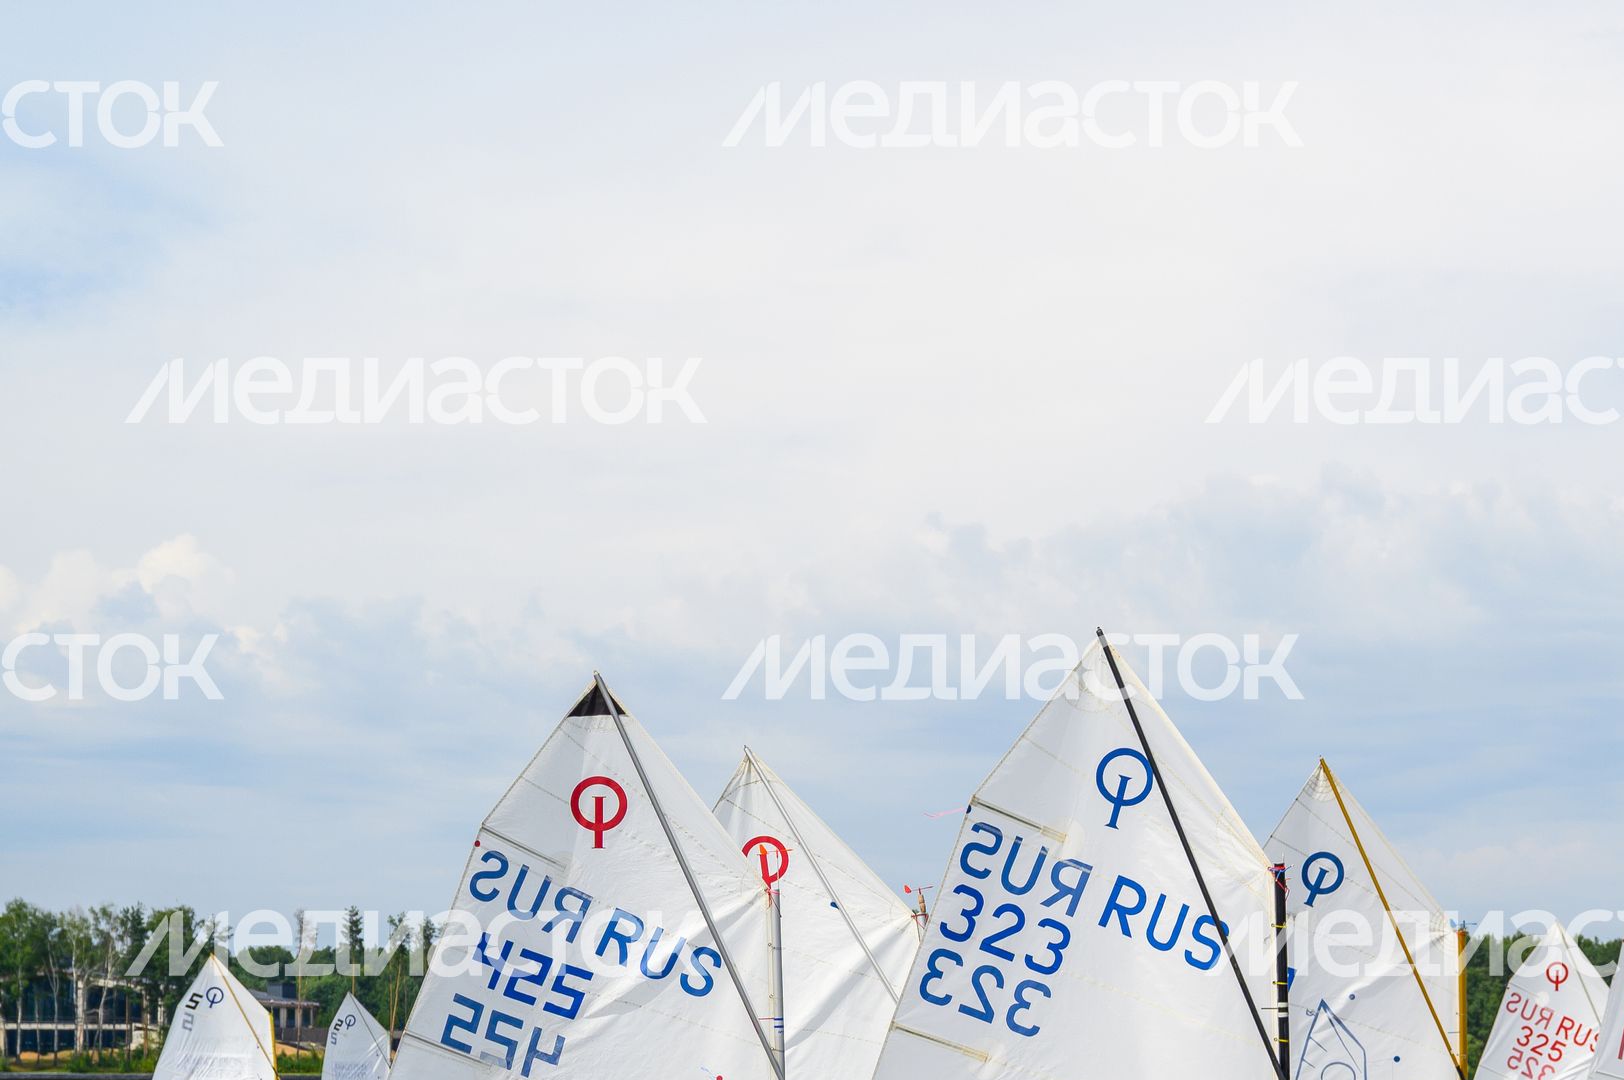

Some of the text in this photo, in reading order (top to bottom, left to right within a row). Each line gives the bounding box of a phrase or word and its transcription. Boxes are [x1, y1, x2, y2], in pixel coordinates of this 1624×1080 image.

[595, 907, 722, 997] RUS
[939, 883, 1071, 975] 323
[1097, 874, 1230, 971] RUS
[472, 932, 593, 1020] 425
[1516, 1025, 1567, 1062] 325
